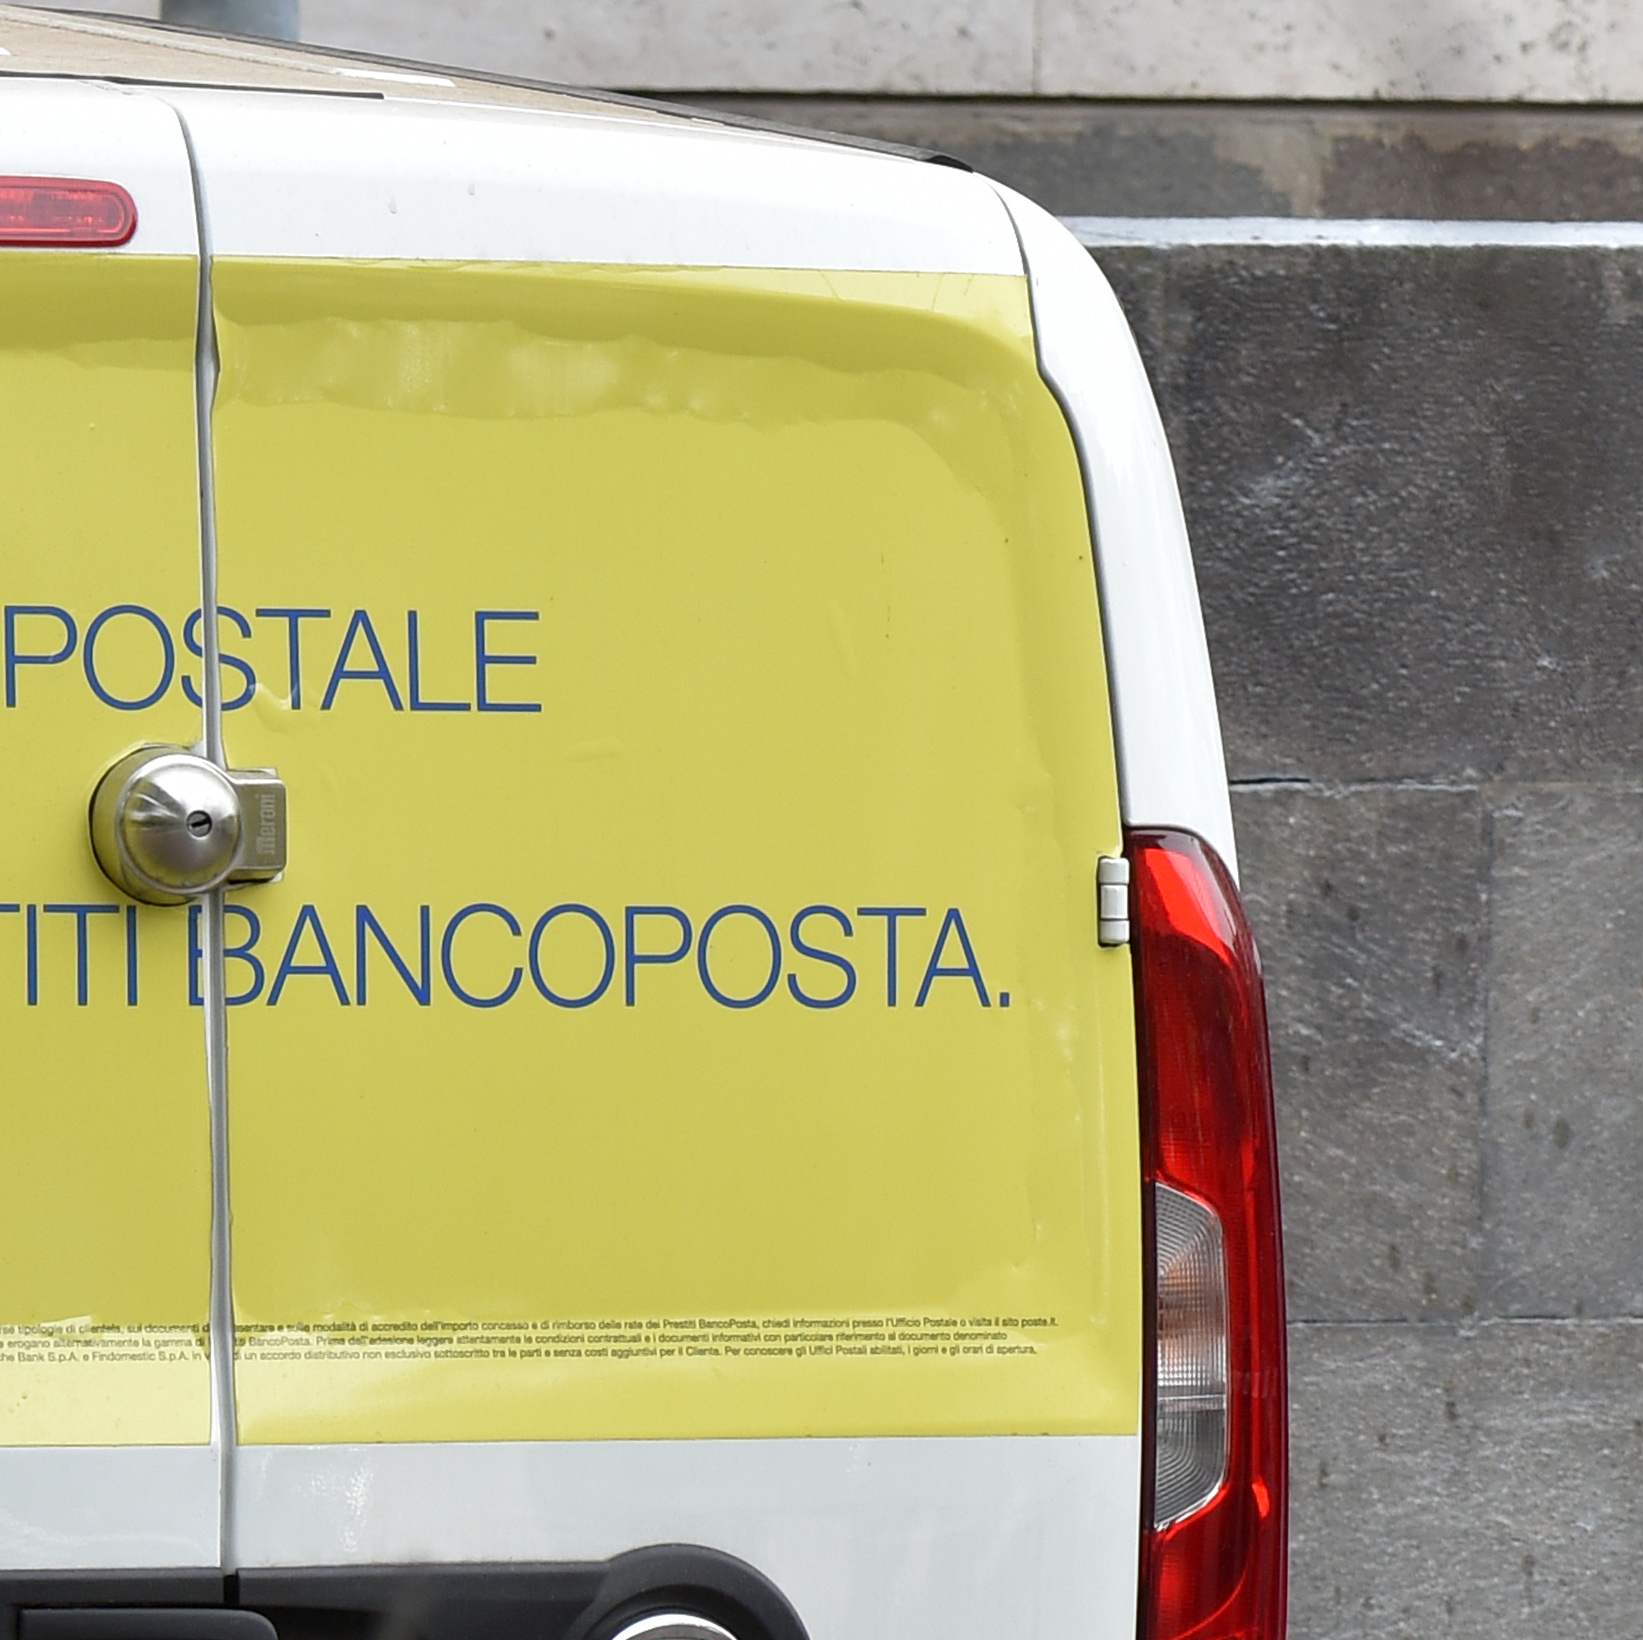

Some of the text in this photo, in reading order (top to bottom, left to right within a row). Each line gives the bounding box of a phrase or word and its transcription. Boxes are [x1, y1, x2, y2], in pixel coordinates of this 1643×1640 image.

[4, 604, 542, 712] POSTALE
[0, 902, 1011, 1008] ITI BANCOPOSTA.
